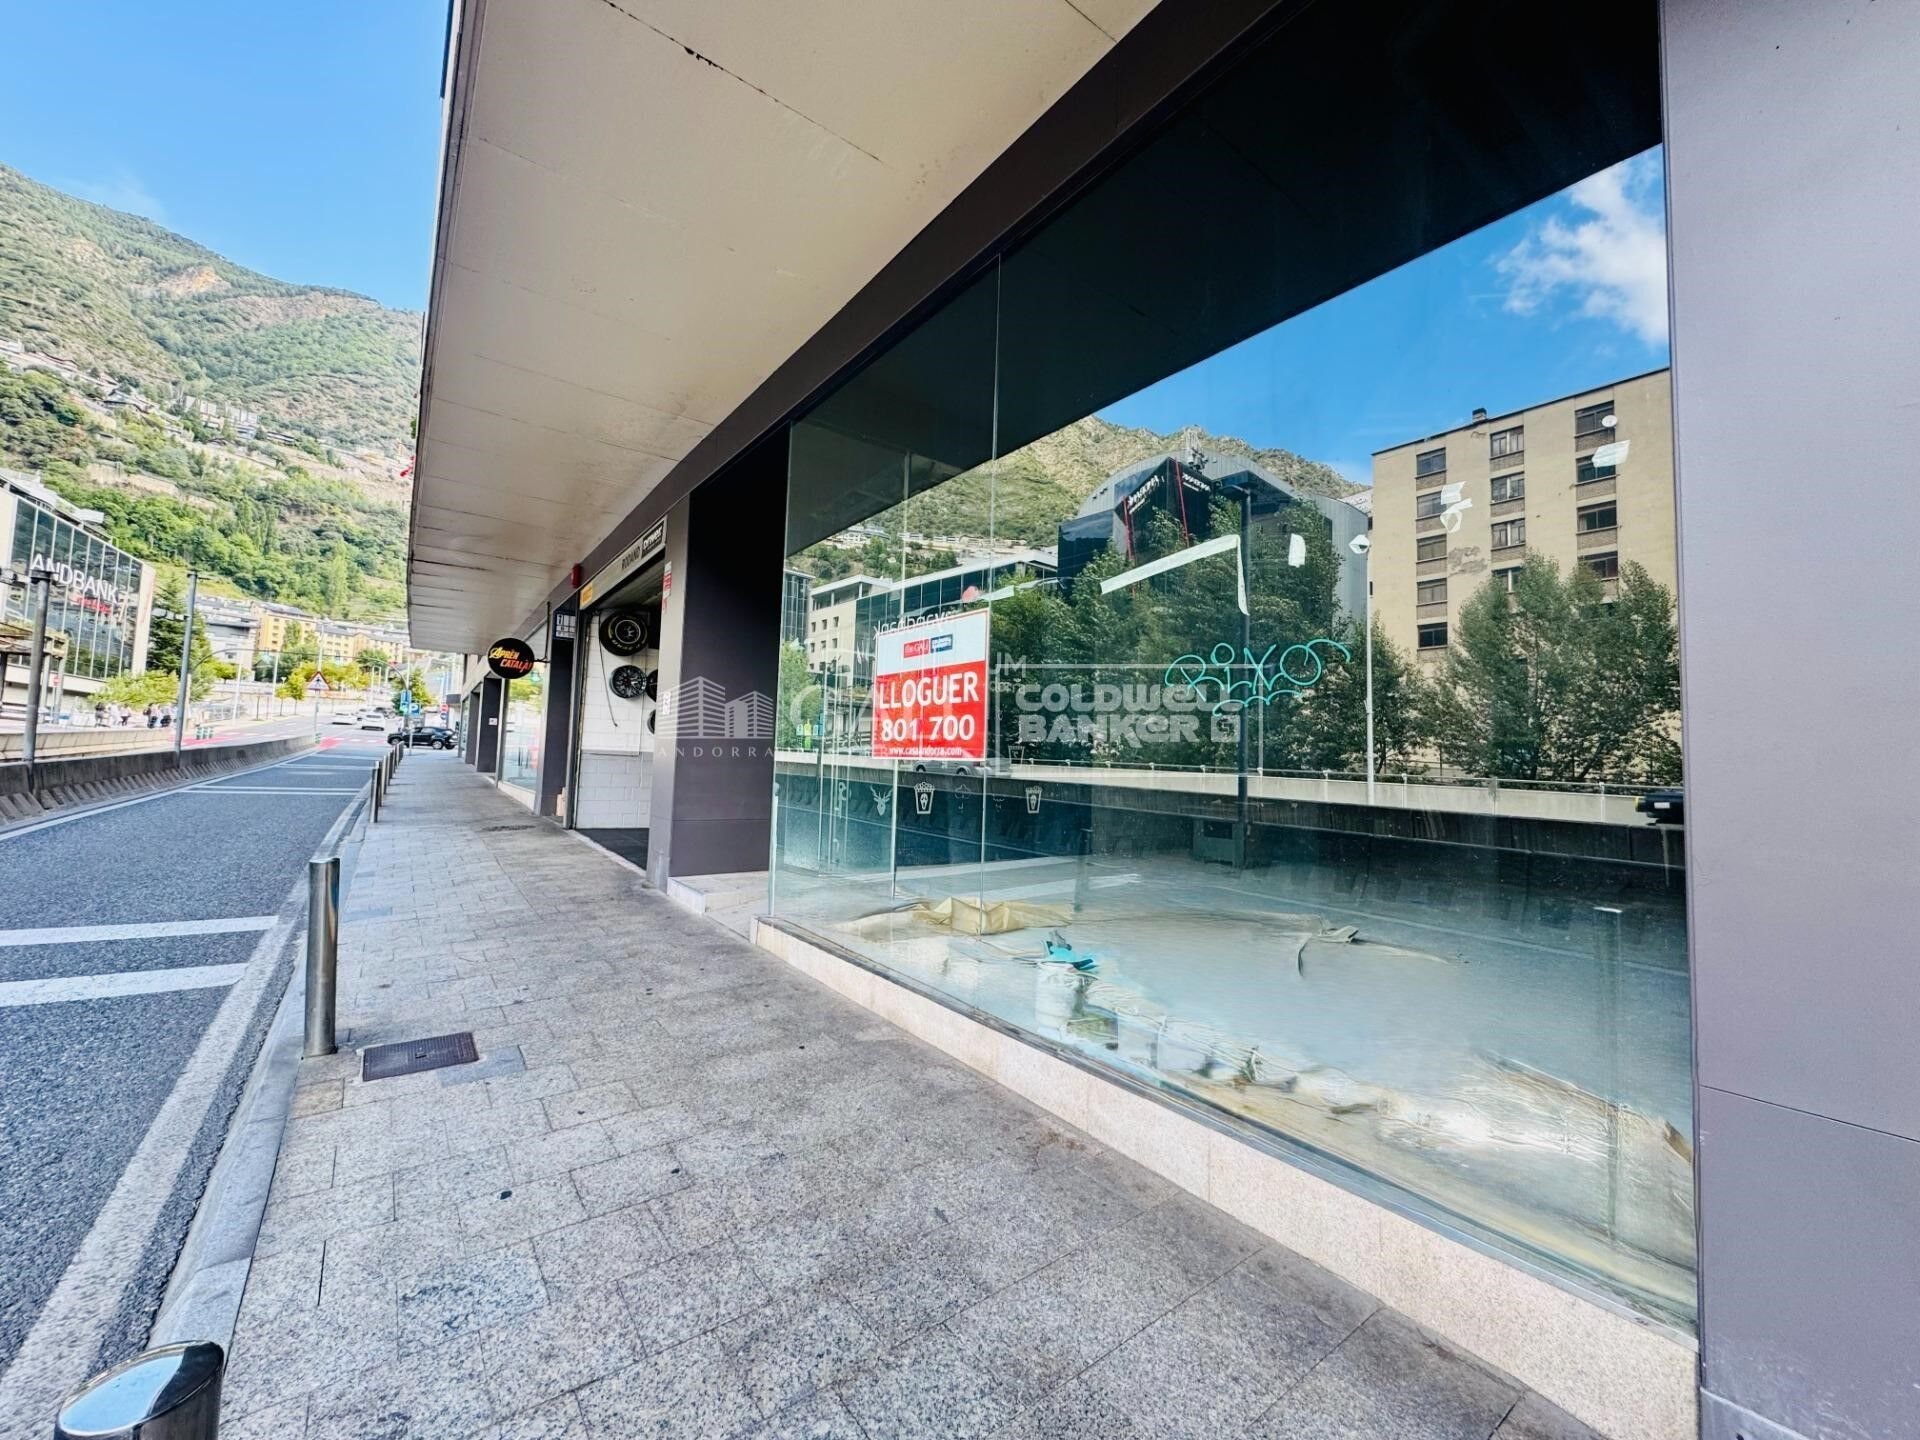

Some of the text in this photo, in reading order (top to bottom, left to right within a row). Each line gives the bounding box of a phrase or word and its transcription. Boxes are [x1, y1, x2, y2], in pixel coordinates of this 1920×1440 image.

[30, 553, 118, 604] ANDBANK
[879, 671, 980, 710] LLOGUER
[881, 713, 976, 741] 801 700
